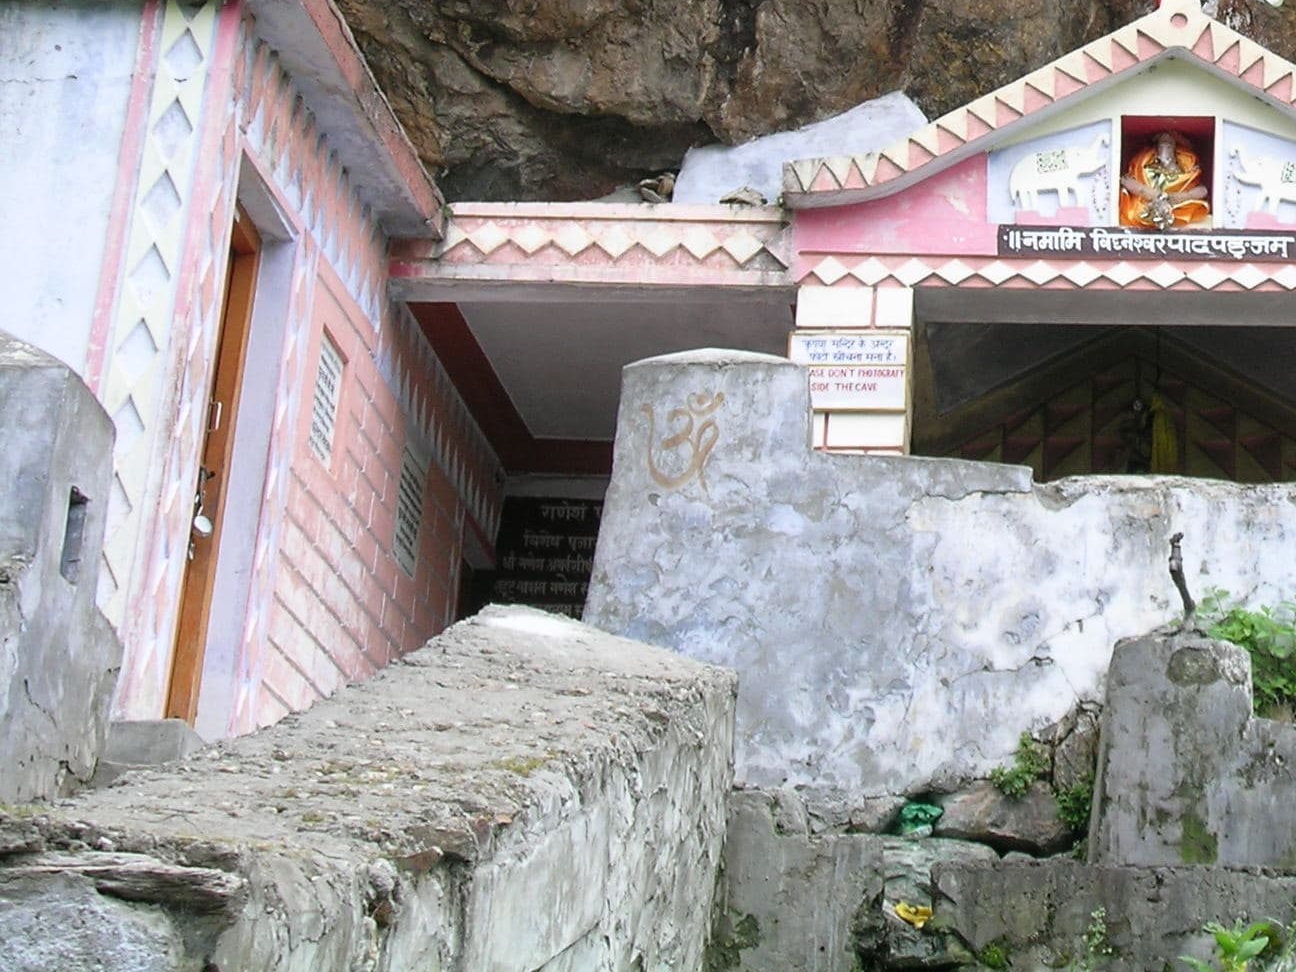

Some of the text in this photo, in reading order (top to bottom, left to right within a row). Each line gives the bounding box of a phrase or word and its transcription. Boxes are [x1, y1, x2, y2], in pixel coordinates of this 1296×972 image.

[828, 369, 855, 377] DON'T
[835, 382, 853, 391] THE
[854, 382, 878, 391] CAVE
